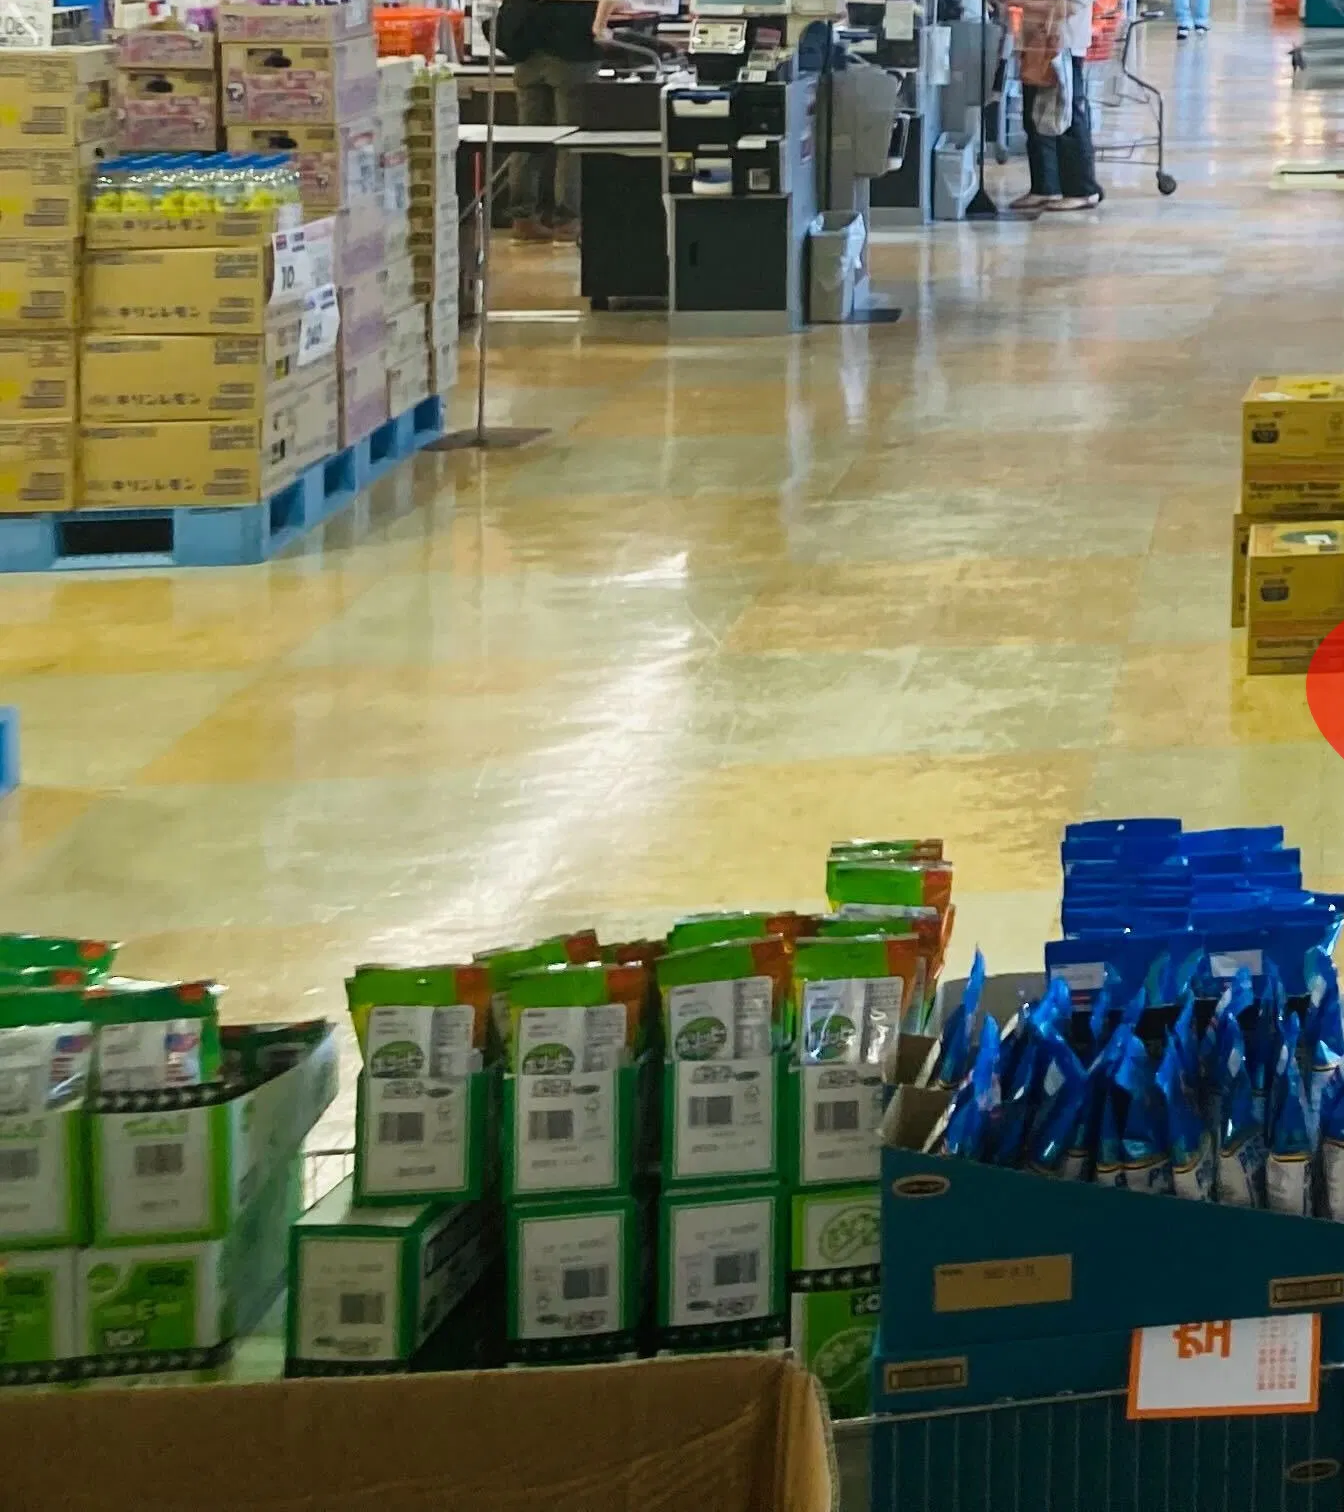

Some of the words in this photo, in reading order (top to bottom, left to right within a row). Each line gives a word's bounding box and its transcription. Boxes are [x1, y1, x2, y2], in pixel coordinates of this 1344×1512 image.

[119, 306, 201, 319] キリンレモン
[117, 392, 202, 406] キリンレモン
[112, 478, 197, 492] キリンレモン
